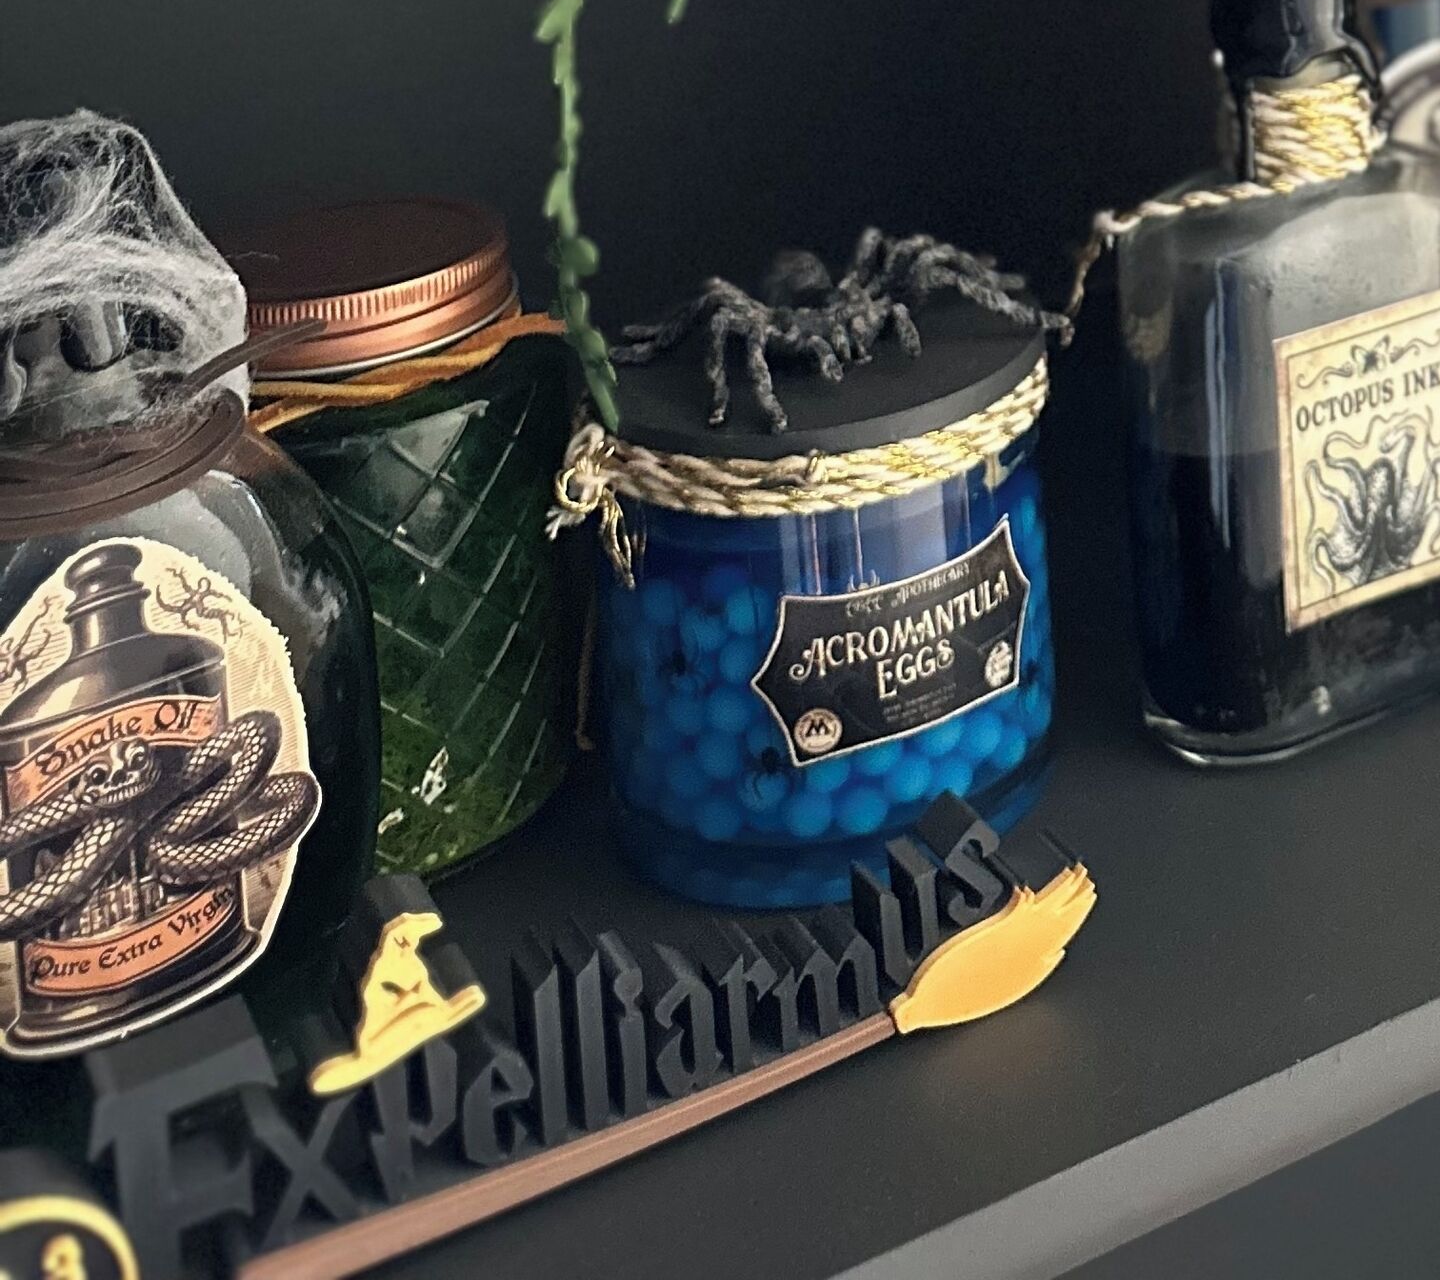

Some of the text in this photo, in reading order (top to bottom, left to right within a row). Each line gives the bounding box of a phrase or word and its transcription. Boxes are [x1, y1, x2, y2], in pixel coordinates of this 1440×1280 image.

[1296, 377, 1395, 432] OCTOPUS
[788, 569, 1010, 680] ACROMANTULA
[876, 638, 956, 699] EGGS
[35, 714, 143, 776] Snake
[31, 886, 234, 986] Pure Extra Virgin
